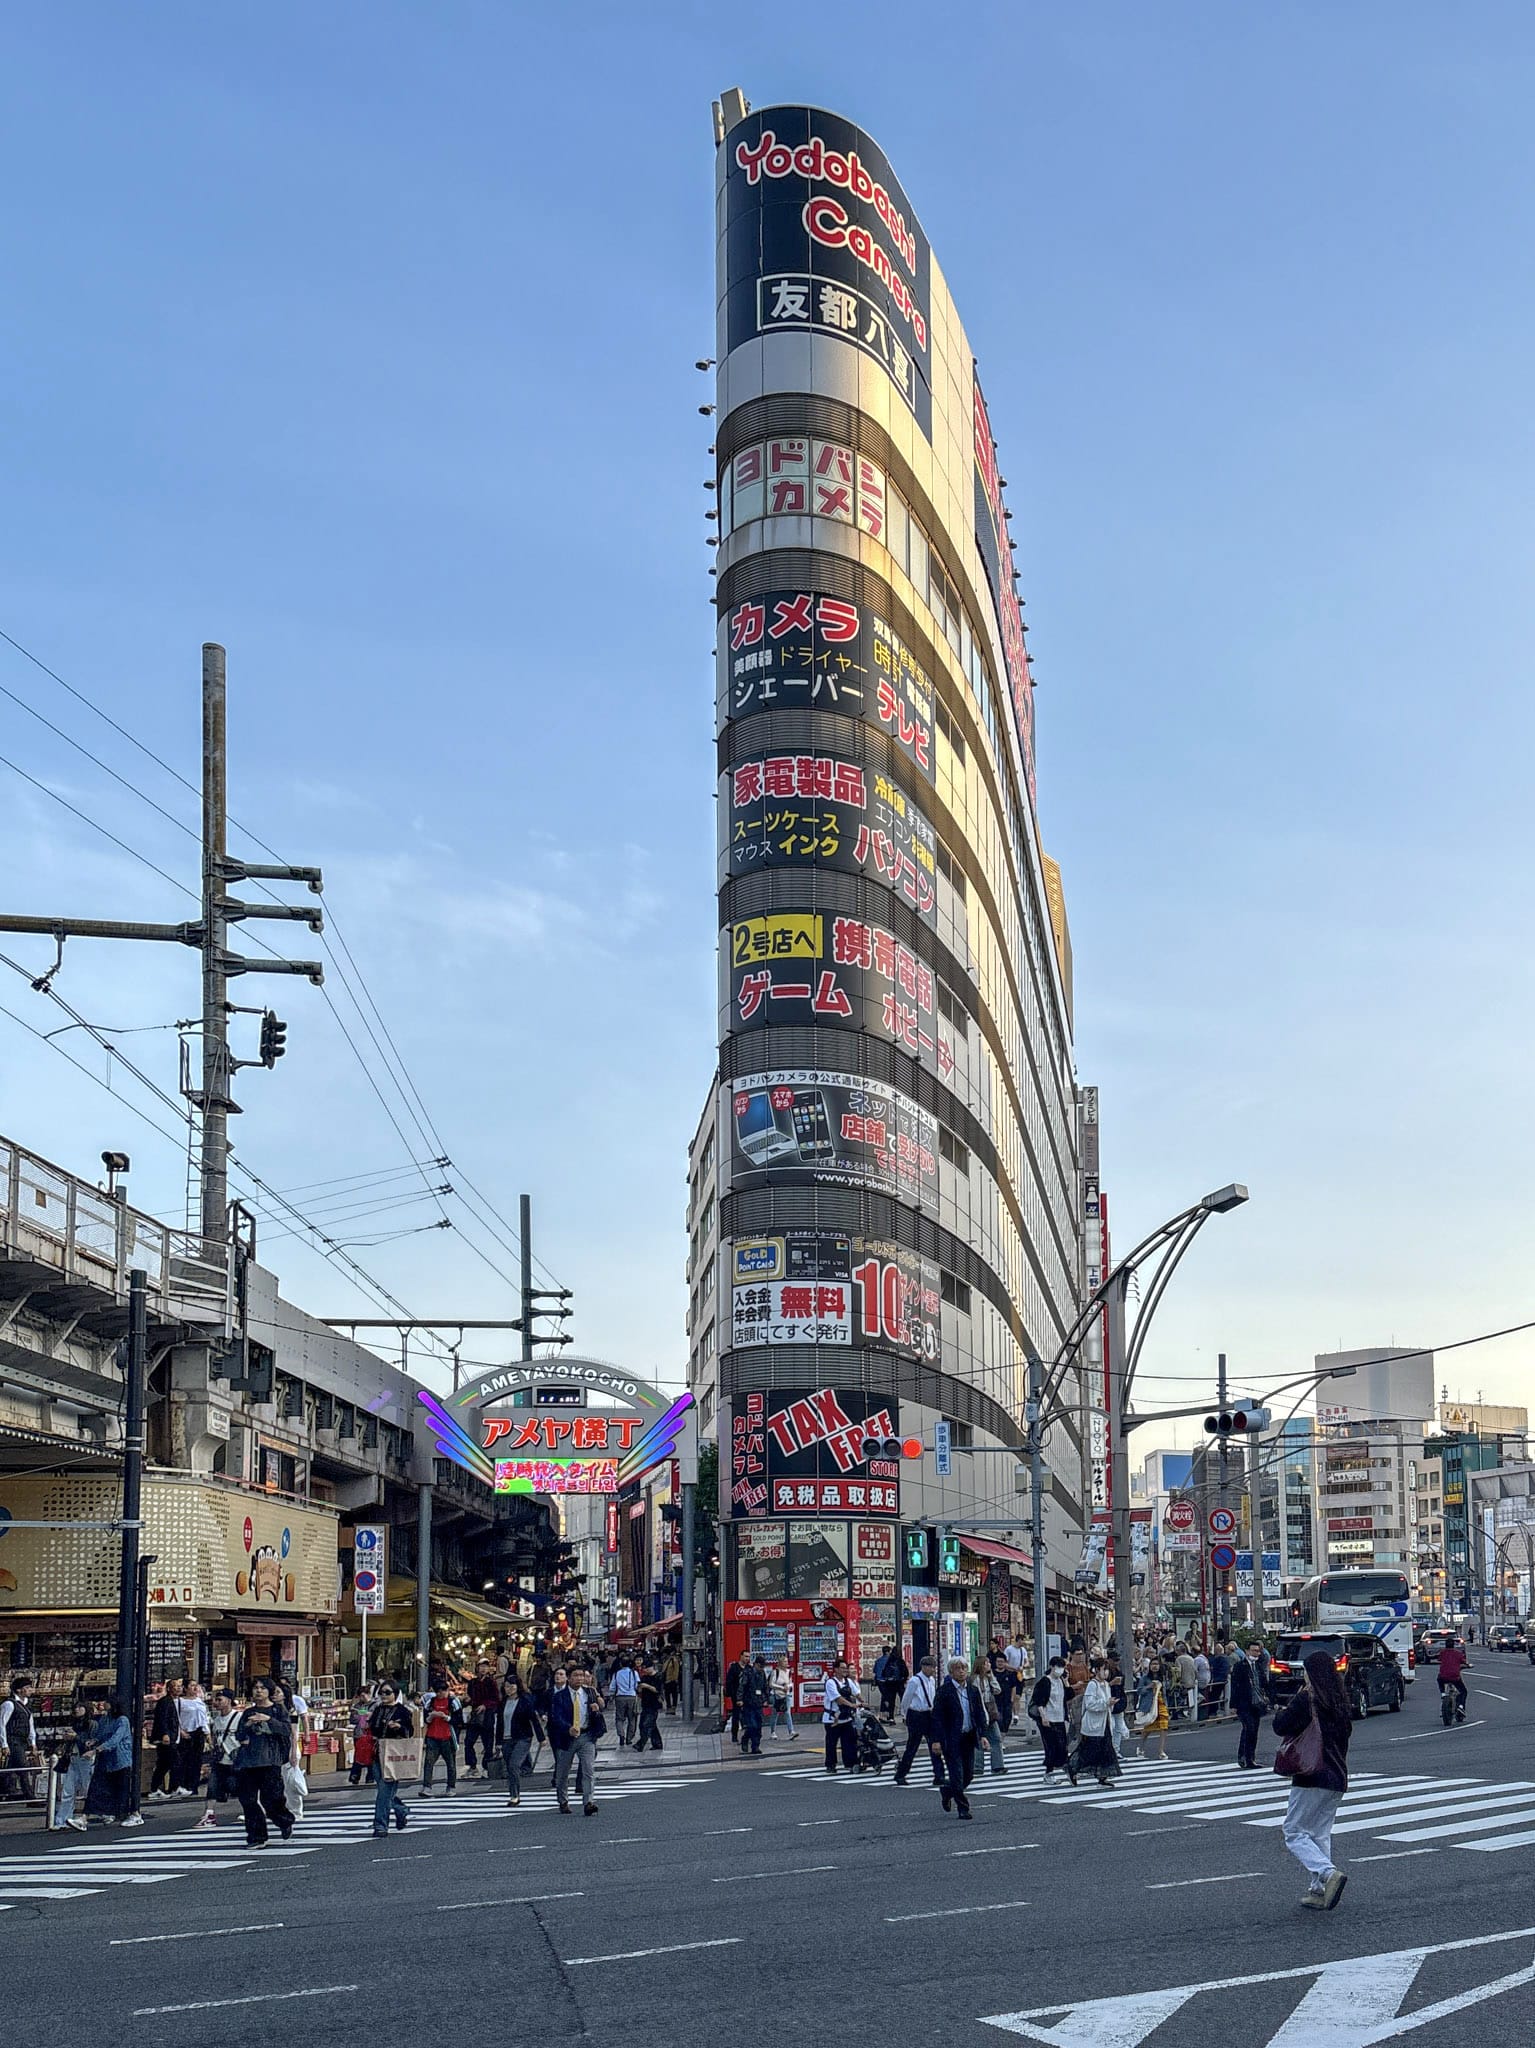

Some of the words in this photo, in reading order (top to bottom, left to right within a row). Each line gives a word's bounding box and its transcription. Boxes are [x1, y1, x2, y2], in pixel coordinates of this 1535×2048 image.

[736, 130, 916, 276] Yodobashi
[802, 196, 926, 352] Camera
[735, 440, 884, 500] ヨドバシ
[771, 480, 884, 537] カメラ
[731, 593, 859, 651] カメラ
[780, 645, 868, 674] ドライヤー
[873, 638, 903, 688] 時計
[877, 677, 930, 770] テレビ
[733, 756, 867, 810] 家電製品
[734, 810, 840, 842] スーツケース
[734, 840, 773, 863] マウス
[779, 834, 840, 857] インク
[853, 824, 935, 912] パソコン
[735, 924, 816, 963] 2号店へ
[833, 916, 932, 1015] 携帯電話
[738, 970, 853, 1020] ゲーム
[882, 992, 934, 1052] ホビー
[773, 1091, 791, 1100] スマホ
[776, 1099, 790, 1107] から
[738, 1261, 756, 1272] POINT
[756, 1260, 775, 1270] CARD
[743, 1248, 768, 1261] GOLD
[735, 1287, 771, 1306] 入会金
[780, 1285, 846, 1319] 無料
[734, 1306, 771, 1325] 年会費
[734, 1324, 849, 1345] 店頭にてすぐ発行
[482, 1417, 643, 1449] アメヤ横丁
[747, 1393, 764, 1474] ヨドバシ
[767, 1388, 852, 1458] TAX
[733, 1415, 746, 1476] カメラ
[937, 1425, 948, 1473] 歩車分離式
[870, 1460, 899, 1477] STORE
[1093, 1466, 1105, 1501] ルノアール
[731, 1477, 753, 1504] TAX
[742, 1483, 768, 1510] FREE
[777, 1485, 896, 1508] 免税品取扱店
[790, 1523, 843, 1533] でお買い物なら
[823, 1567, 846, 1580] VISA
[1236, 1571, 1247, 1580] MI
[1262, 1571, 1273, 1580] MI
[736, 1605, 766, 1617] Coca-Cola
